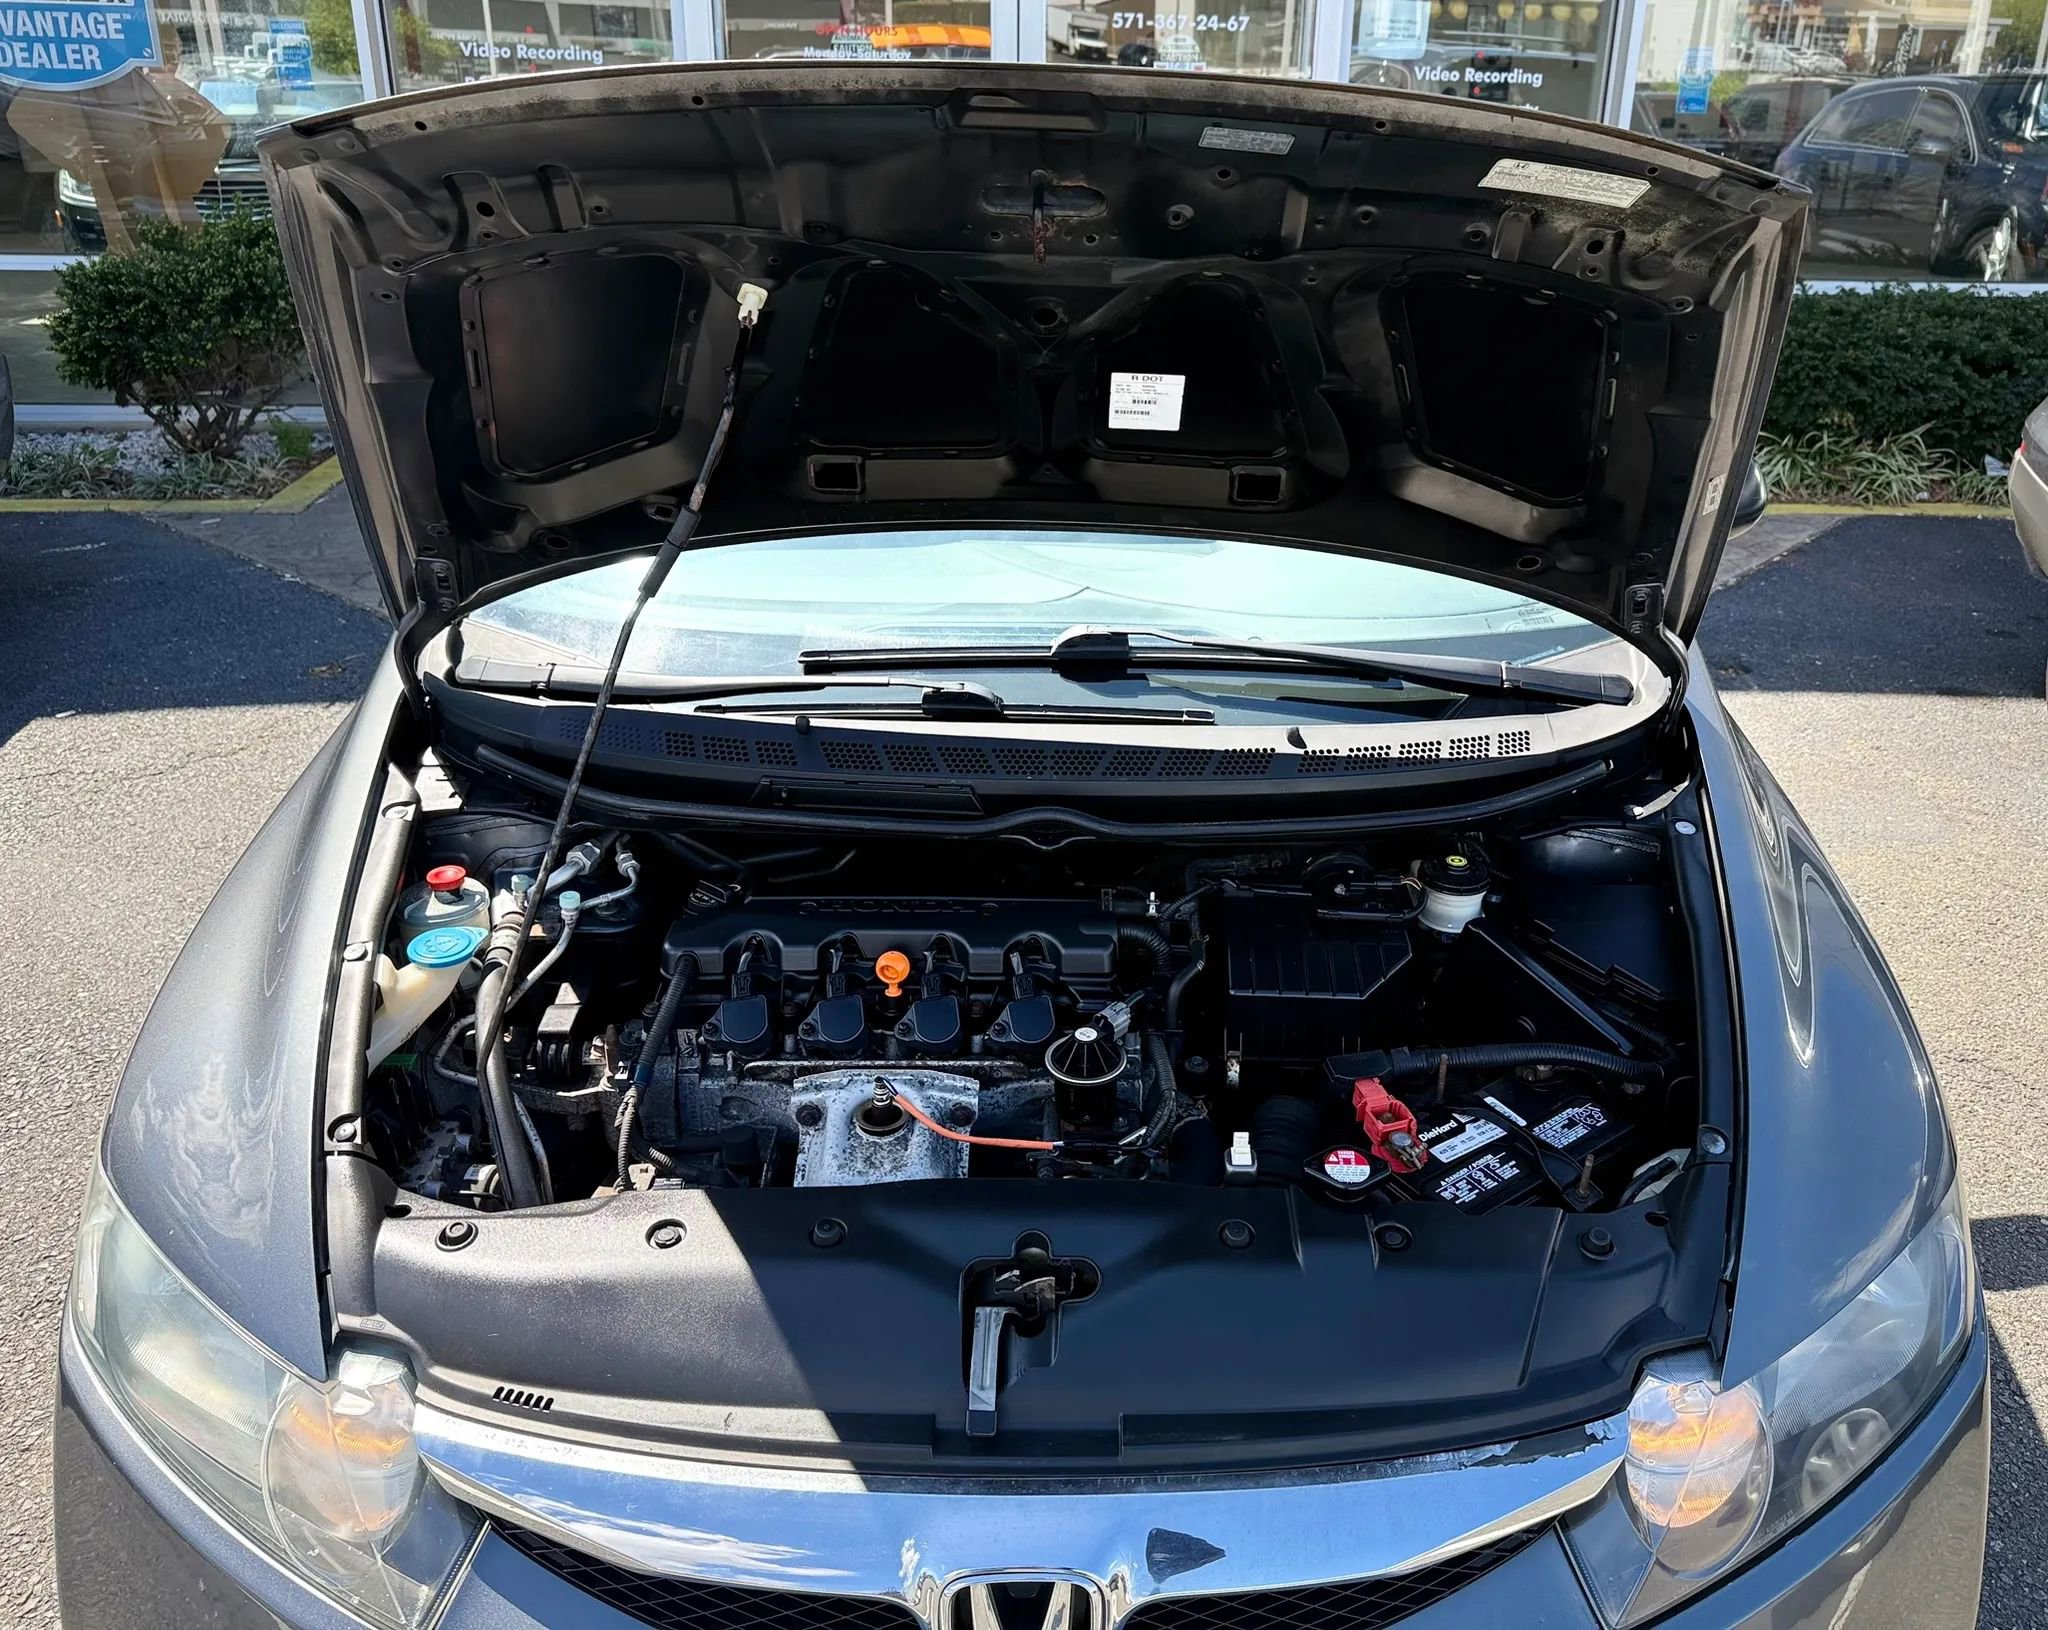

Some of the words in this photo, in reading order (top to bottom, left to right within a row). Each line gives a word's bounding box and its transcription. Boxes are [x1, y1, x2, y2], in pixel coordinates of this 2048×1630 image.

[1112, 12, 1250, 31] 571-367-24-67
[0, 41, 103, 71] DEALER
[459, 41, 511, 58] Video
[517, 44, 603, 64] Recording
[803, 46, 912, 60] Monday-Saturday
[1414, 66, 1460, 83] Video
[1465, 67, 1543, 88] Recording
[1418, 1119, 1458, 1142] DieHard
